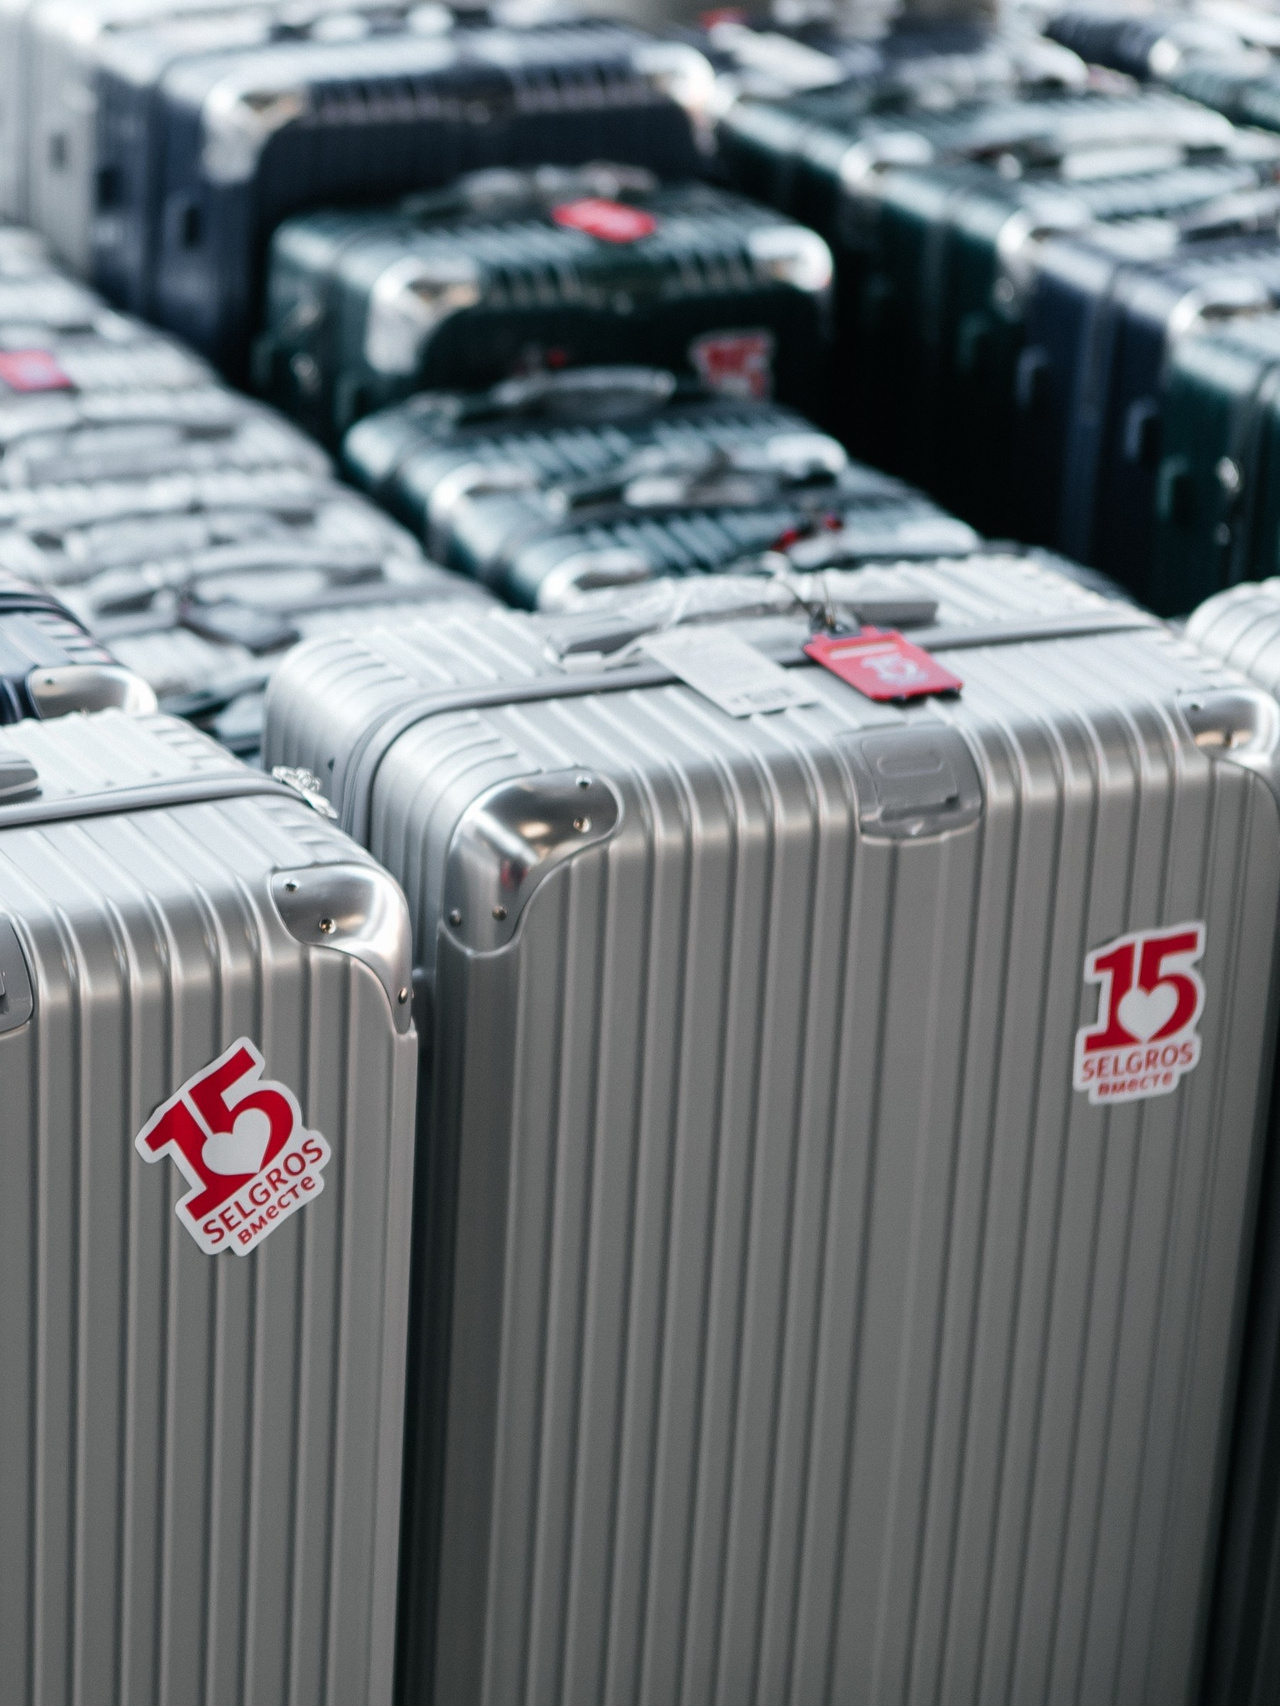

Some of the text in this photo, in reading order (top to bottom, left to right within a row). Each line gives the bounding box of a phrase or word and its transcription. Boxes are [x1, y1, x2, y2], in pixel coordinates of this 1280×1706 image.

[1084, 930, 1199, 1053] 15
[1082, 1042, 1194, 1082] SELGROS
[144, 1046, 294, 1221] 15
[202, 1139, 323, 1244] SELGROS
